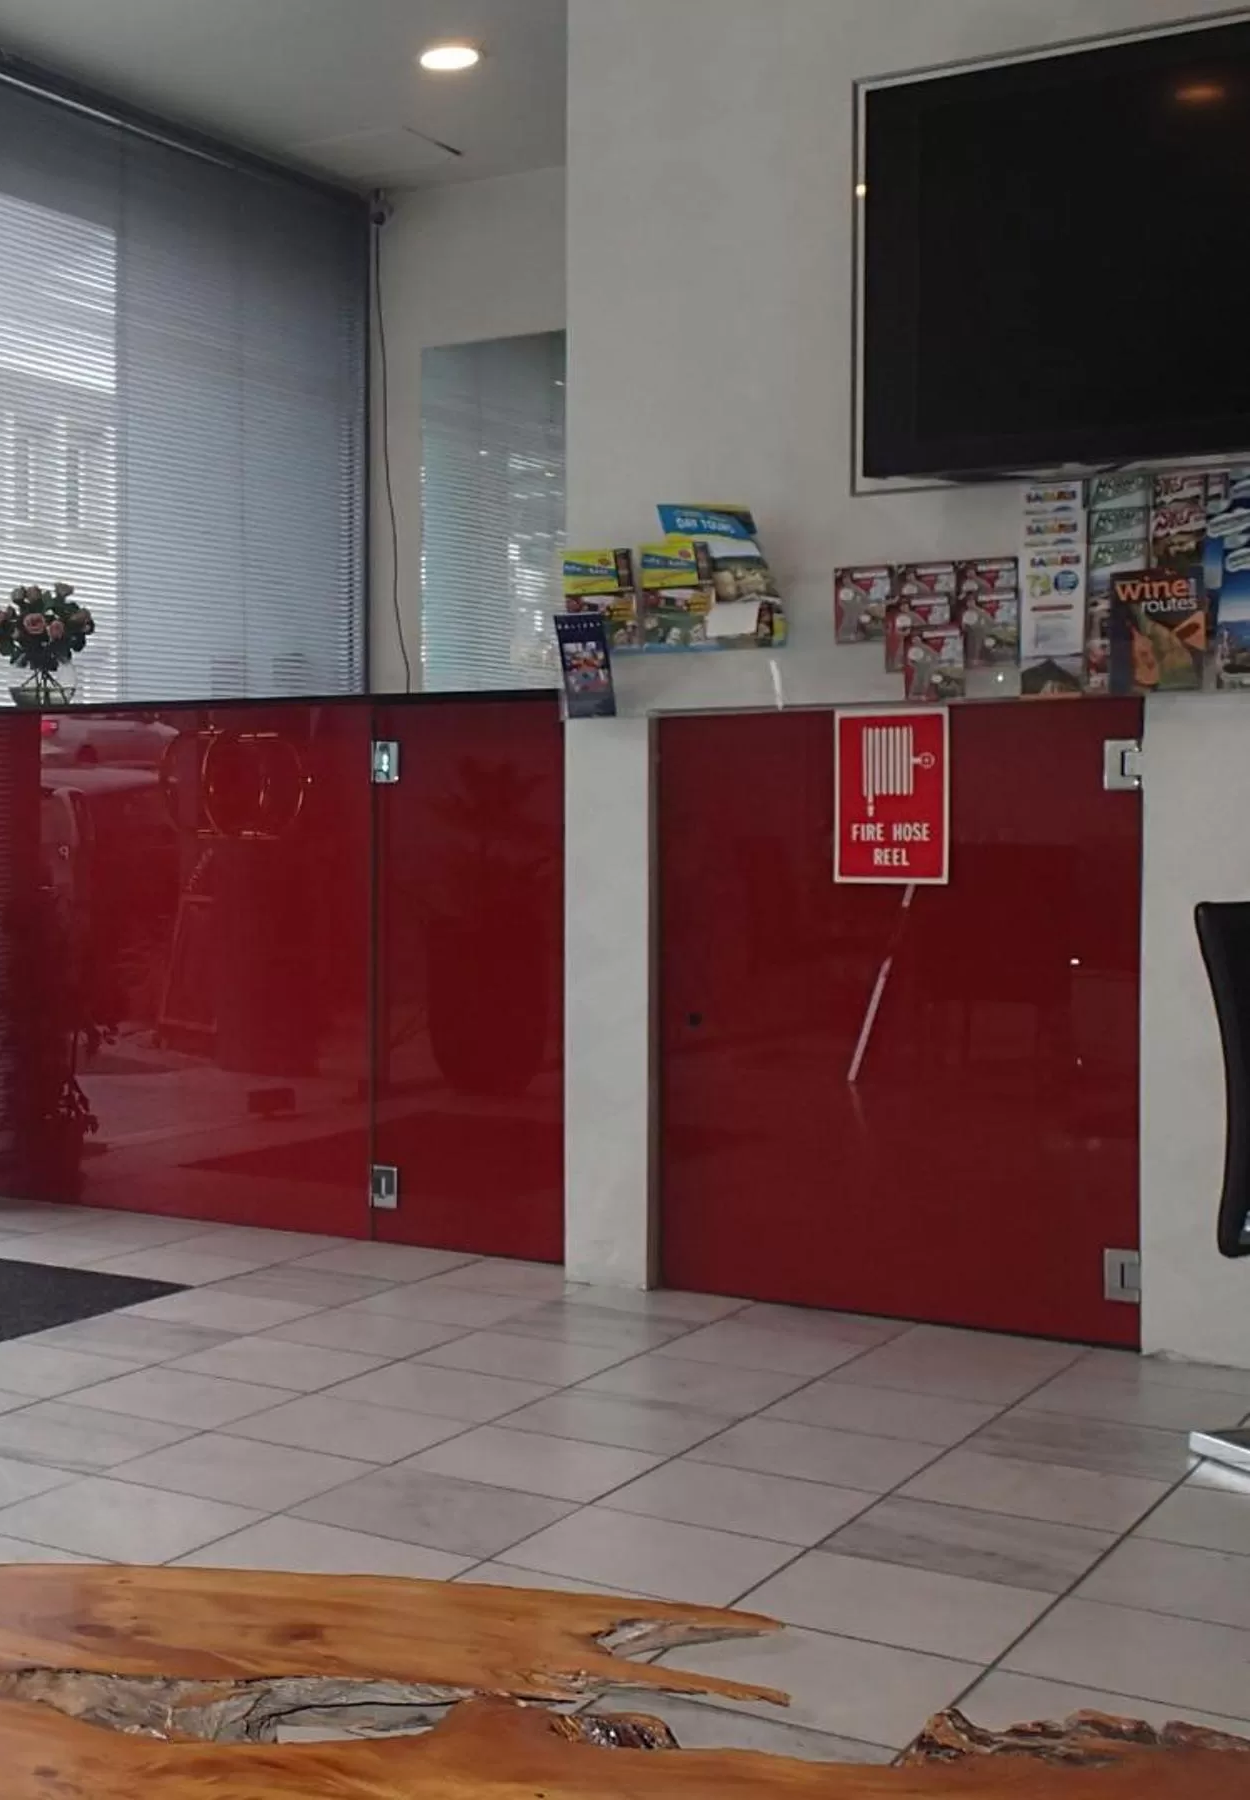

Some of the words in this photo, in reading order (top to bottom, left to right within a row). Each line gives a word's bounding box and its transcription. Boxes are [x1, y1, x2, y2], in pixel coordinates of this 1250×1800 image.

[1115, 576, 1188, 602] wine
[1141, 598, 1197, 613] routes
[851, 822, 885, 842] FIRE
[892, 822, 931, 842] HOSE
[873, 847, 910, 866] REEL
